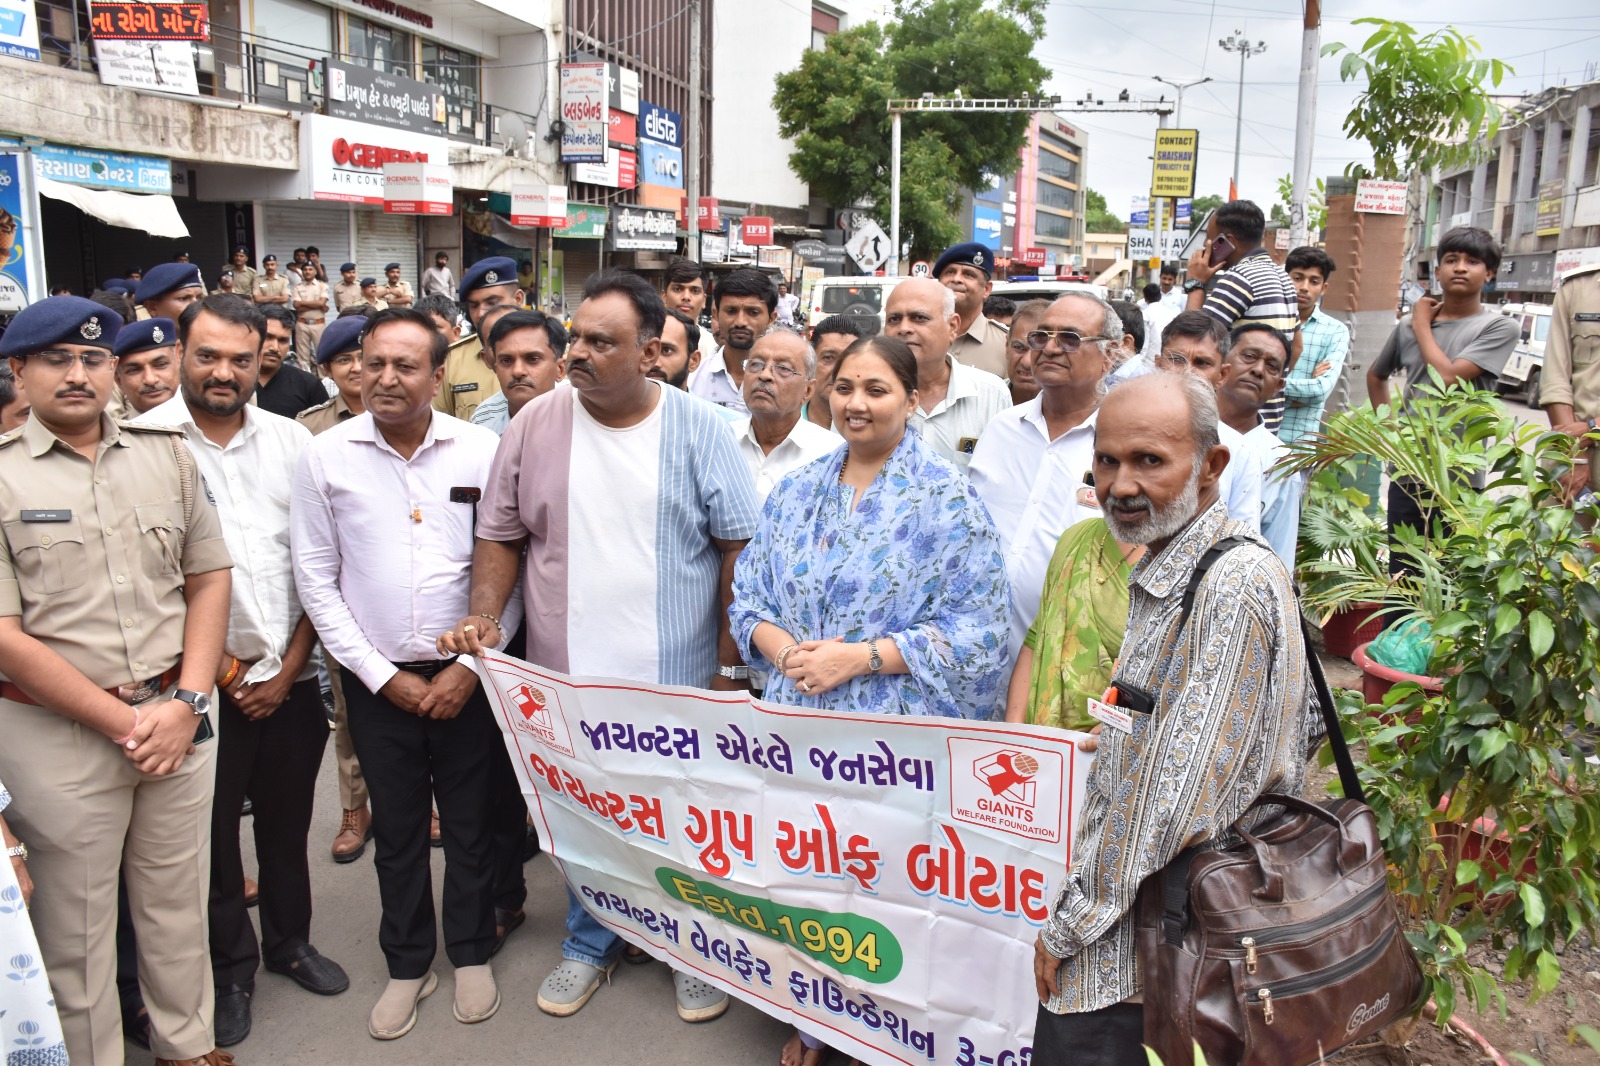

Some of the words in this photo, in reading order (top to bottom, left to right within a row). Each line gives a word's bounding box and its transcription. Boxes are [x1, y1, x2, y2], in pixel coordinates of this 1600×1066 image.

[118, 4, 160, 33] રોગો
[382, 93, 390, 108] &
[645, 108, 677, 143] elista
[1159, 137, 1193, 145] CONTACT
[36, 157, 91, 179] ફરસાણ
[652, 152, 679, 177] vivo
[1157, 151, 1192, 161] SHAISHAV
[332, 173, 352, 184] AIR
[684, 207, 708, 216] IB
[746, 225, 767, 233] IFB
[914, 264, 928, 275] 30
[580, 720, 701, 760] જાયન્ટસ
[716, 723, 794, 775] એટલે
[808, 740, 934, 792] જનસેવા
[977, 798, 1034, 822] GIANTS
[957, 807, 997, 824] WELFARE
[999, 818, 1055, 838] FOUNDATION
[529, 752, 668, 842] જાયન્ટસ
[684, 804, 755, 879] ગ્રુપ
[776, 803, 880, 891] ઓફ
[906, 823, 1048, 922] બોટાદ
[672, 874, 882, 974] Estd.1994
[580, 884, 680, 946] જાયન્ટસ
[690, 914, 773, 988] વેલફેર
[787, 971, 935, 1060] ફાઉન્ડેશન
